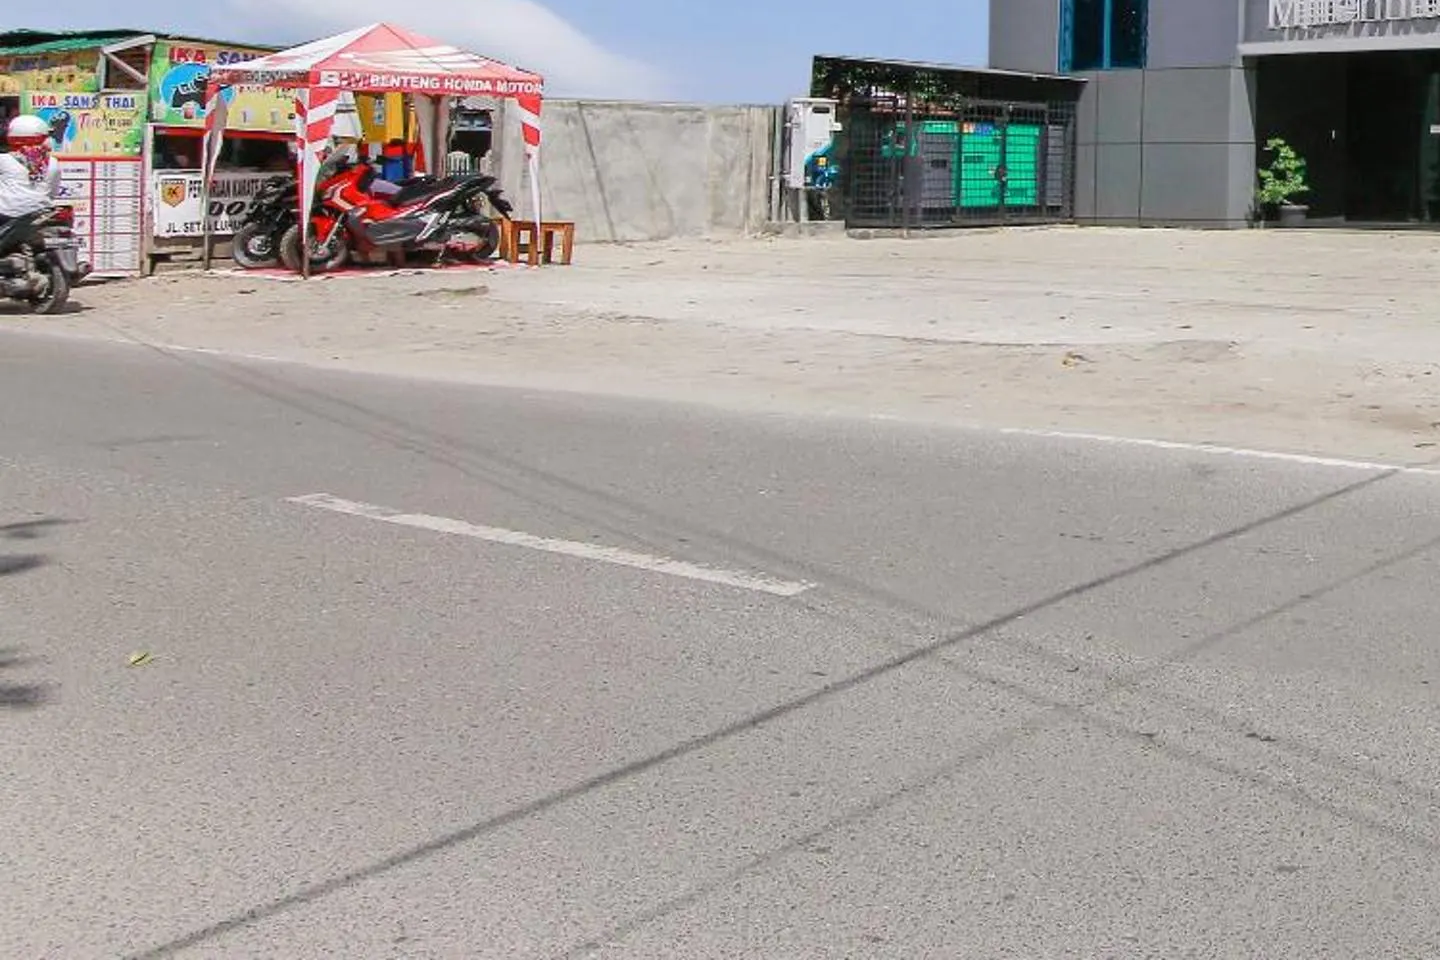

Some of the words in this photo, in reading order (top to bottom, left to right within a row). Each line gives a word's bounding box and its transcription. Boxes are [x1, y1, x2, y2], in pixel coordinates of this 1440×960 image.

[169, 47, 207, 64] IKA
[215, 51, 266, 66] SAN
[370, 74, 440, 89] BENTENG
[444, 76, 492, 91] HONDA
[31, 95, 57, 107] IKA
[63, 96, 100, 109] SANS
[105, 97, 136, 109] THAI
[165, 222, 181, 233] JL.
